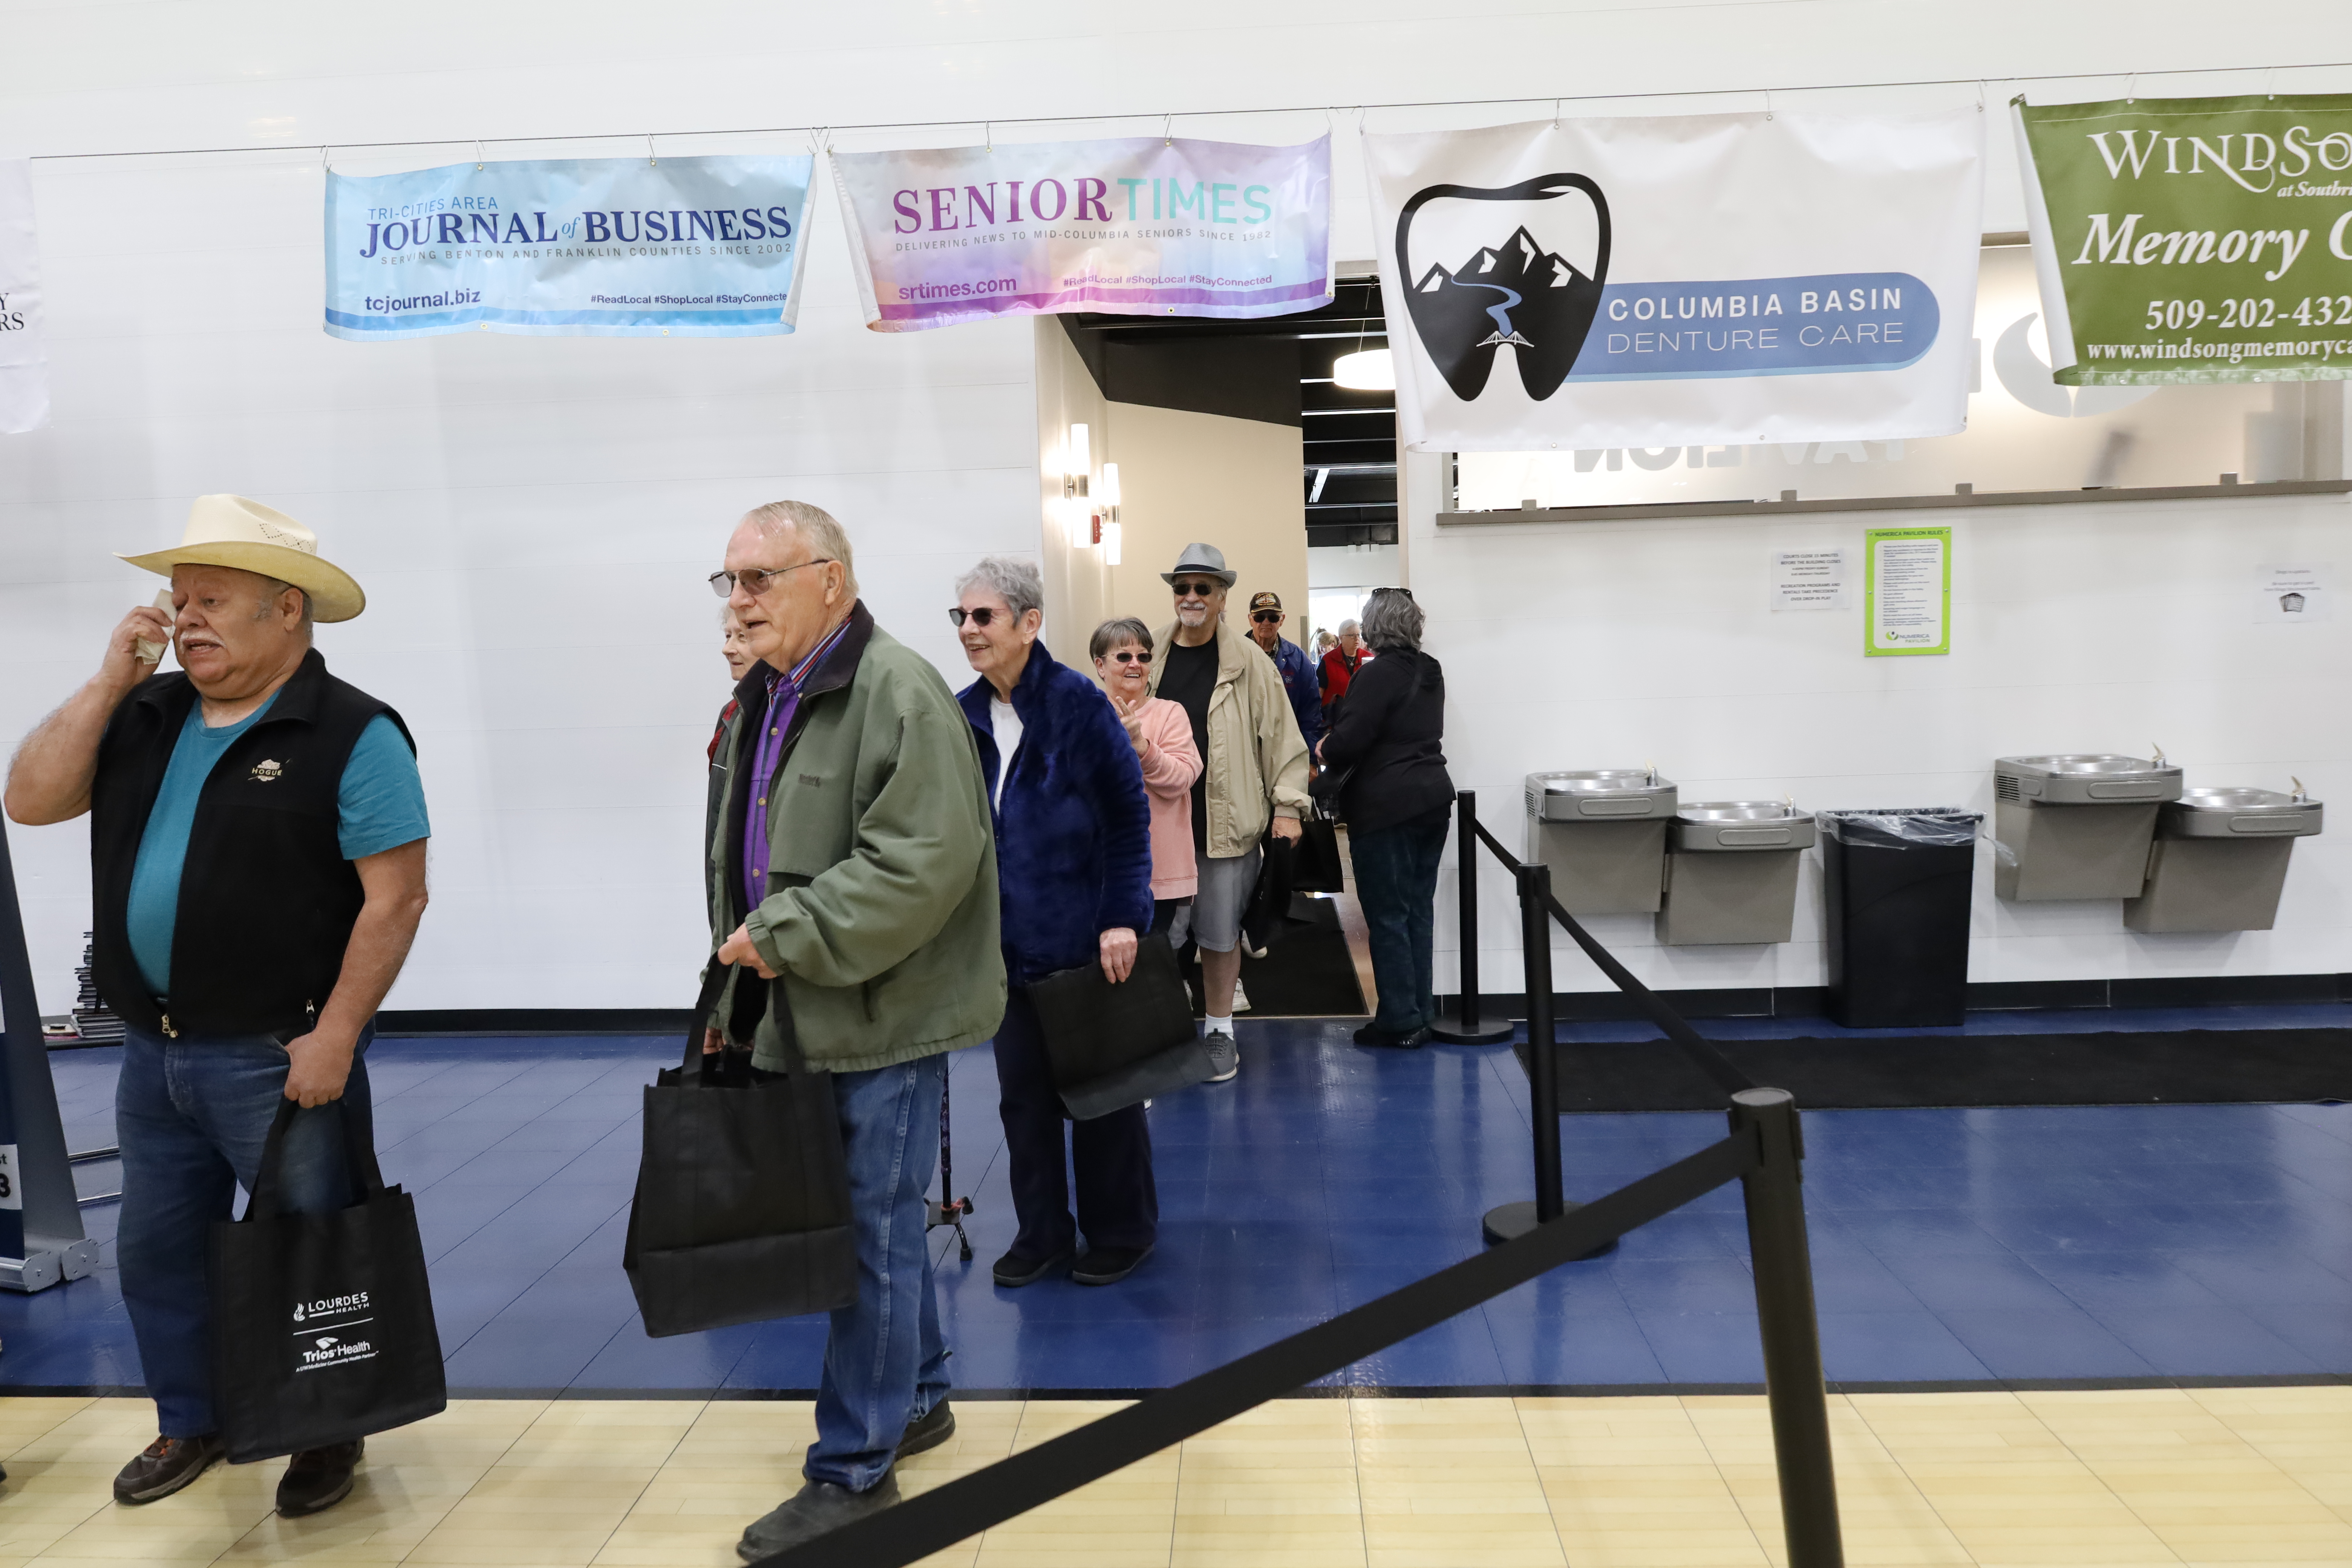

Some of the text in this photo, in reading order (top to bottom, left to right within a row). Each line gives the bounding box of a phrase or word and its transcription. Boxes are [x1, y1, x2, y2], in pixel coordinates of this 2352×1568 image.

[2277, 184, 2294, 197] at
[368, 196, 498, 220] TRI-CITIES AREA
[893, 178, 1271, 234] SENIOR TIMES
[359, 206, 792, 258] JOURNAL of BUSINESS
[896, 228, 1271, 251] DELIVERING NEWS TO MID-COLUMBIA SENIORS SINCE 1982
[381, 243, 792, 265] SERVING BENTON AND FRANKLIN COUNTIES SINCE 2002
[2071, 213, 2310, 282] Memory
[899, 278, 1017, 300] srtimes.com
[1063, 274, 1272, 287] #ReadLocal #ShopLocal #StayConnected
[365, 288, 481, 314] tcjournal.biz
[591, 295, 651, 304] #ReadLocal
[654, 295, 713, 305] #ShopLocal
[1608, 287, 1902, 321] COLUMBIA BASIN
[2145, 295, 2352, 330] 509-202-432
[1608, 322, 1903, 354] DENTURE CARE
[251, 767, 282, 776] HOGUE
[308, 1292, 368, 1312] LOURDES
[336, 1302, 369, 1314] HEALTH
[337, 1340, 371, 1356] Health
